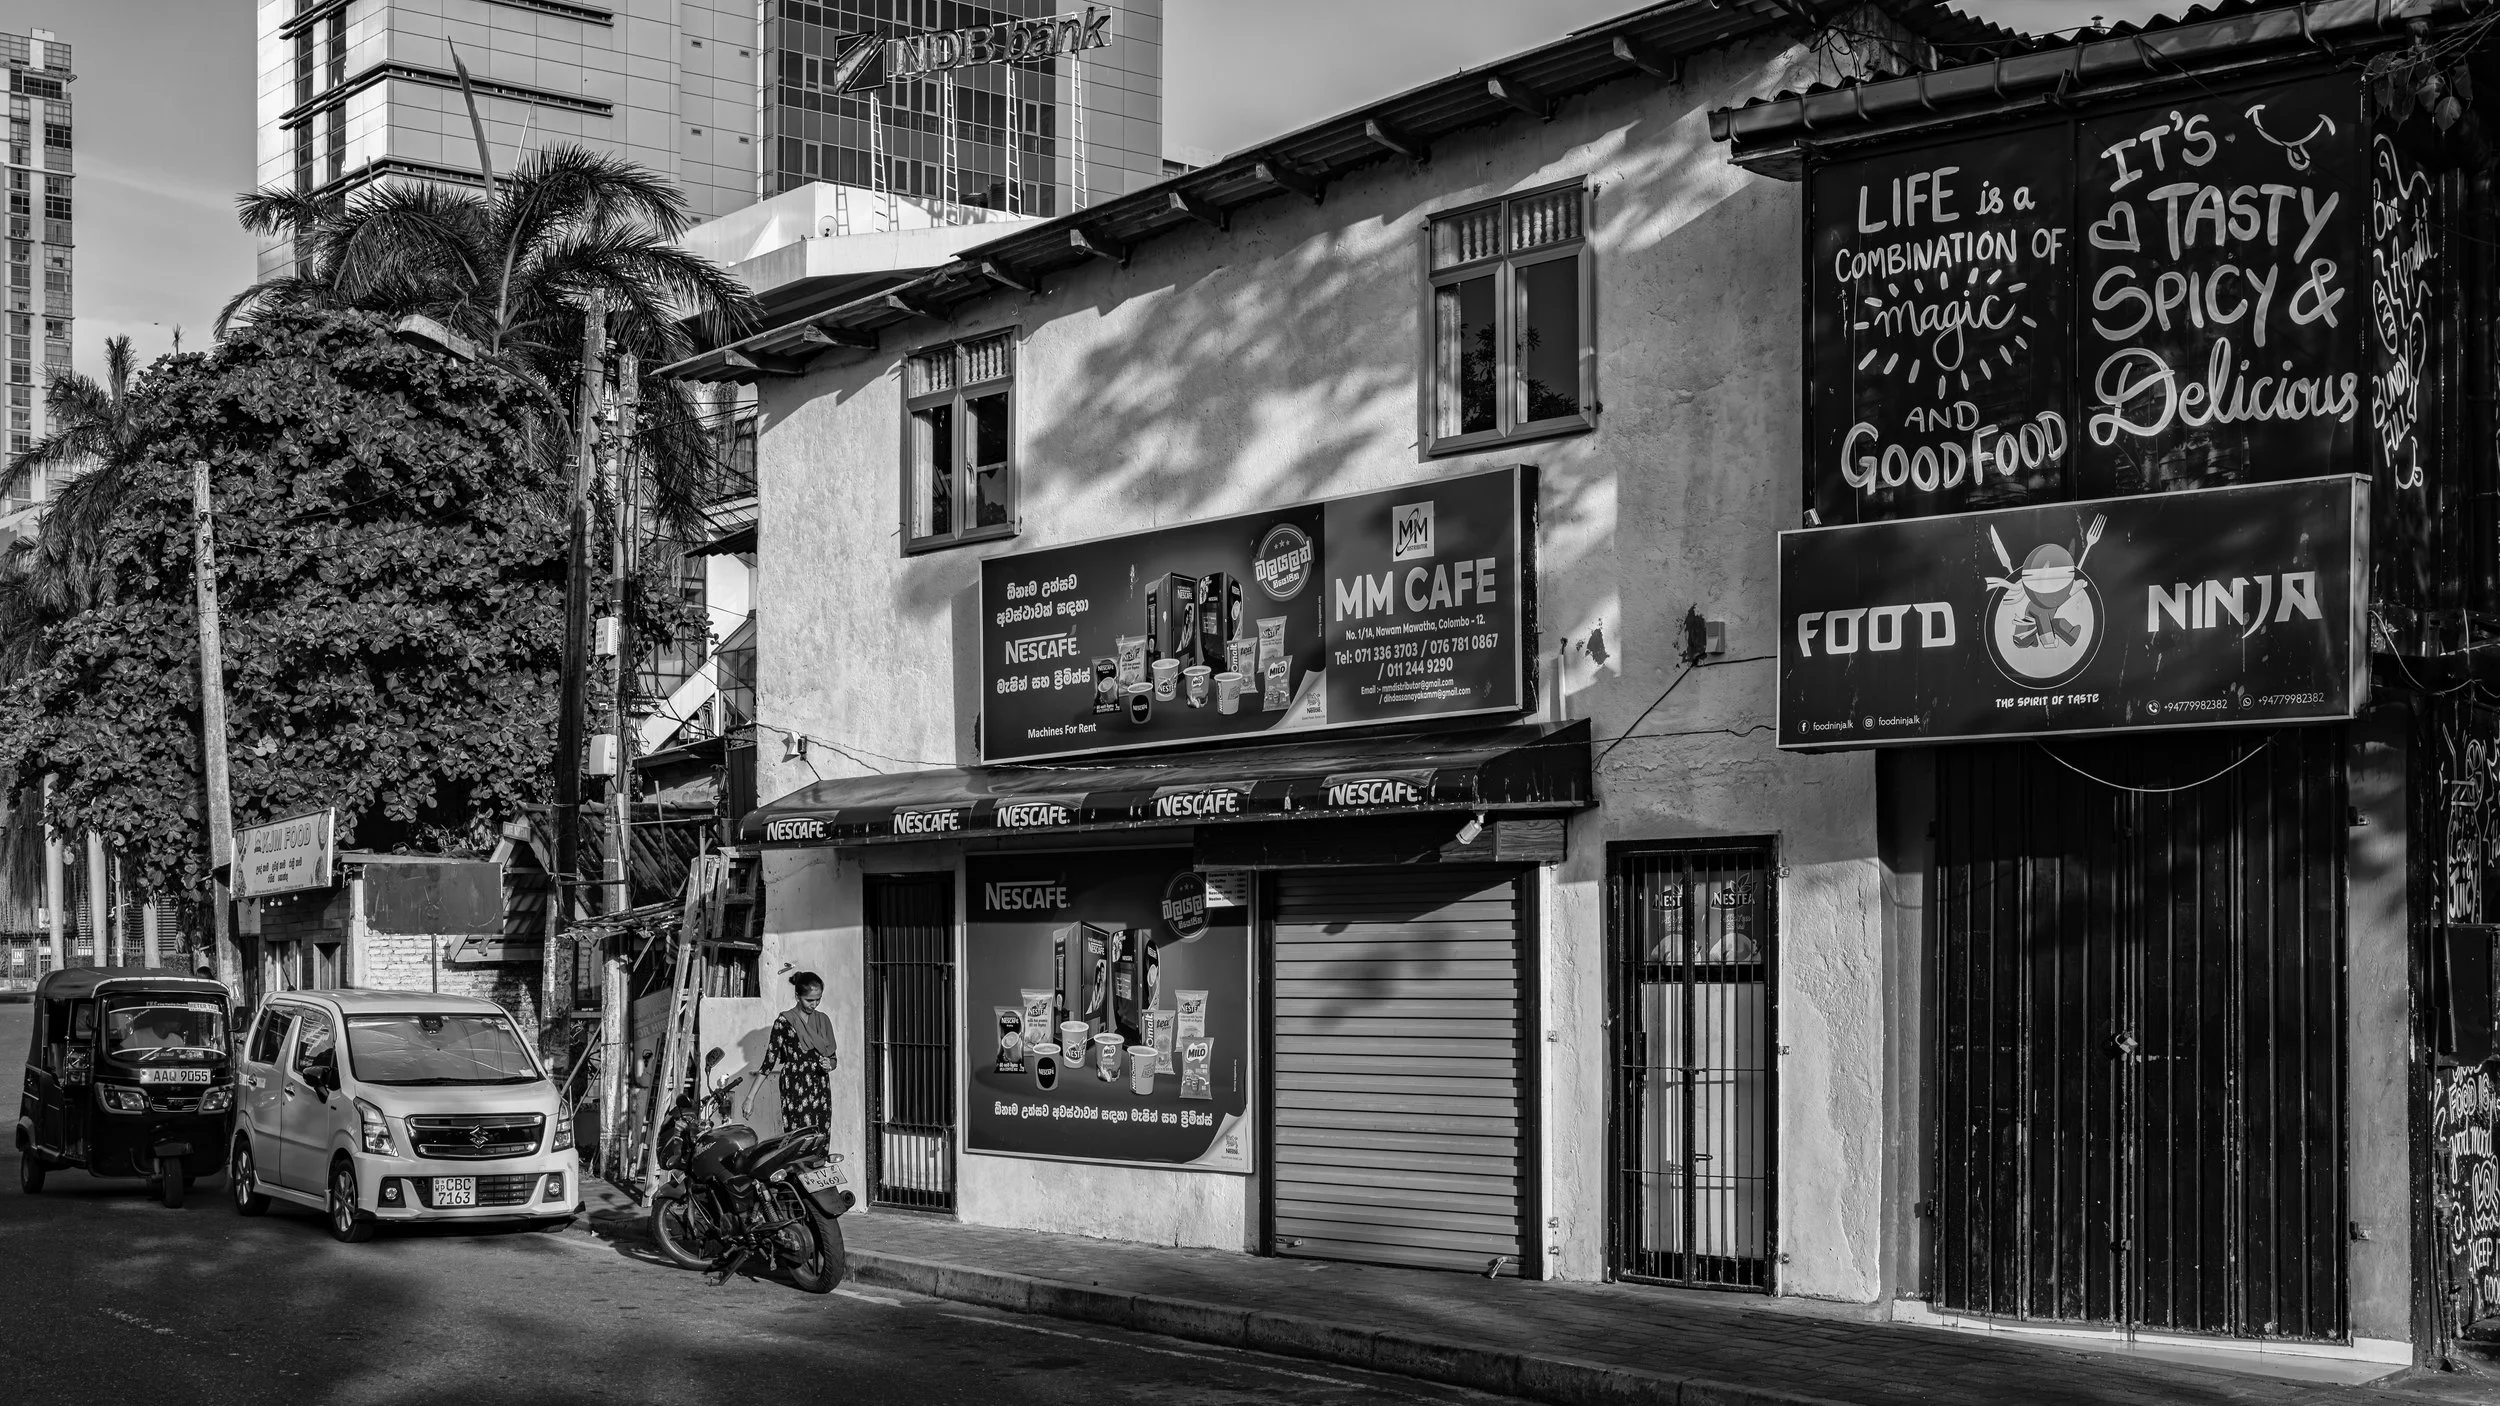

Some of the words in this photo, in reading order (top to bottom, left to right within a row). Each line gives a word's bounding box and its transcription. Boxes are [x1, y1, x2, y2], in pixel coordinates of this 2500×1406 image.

[896, 24, 995, 76] NDB
[1002, 7, 1111, 61] bank
[2101, 109, 2218, 193] IT'S
[1857, 166, 1960, 233] LIFE
[1975, 180, 2003, 216] is
[2012, 186, 2036, 210] a
[2146, 181, 2340, 264] TASTY
[1834, 229, 2018, 283] COMBINATION
[2031, 227, 2067, 265] OF
[2091, 263, 2280, 348] SPICY
[2288, 257, 2347, 329] &
[1873, 290, 2018, 371] magic
[2088, 336, 2360, 446] Delicious
[1904, 400, 1980, 432] AND
[2382, 404, 2411, 468] FULL
[1399, 516, 1428, 546] MM
[1006, 580, 1038, 600] ඕනෑම
[1041, 573, 1078, 598] උත්සව
[1335, 570, 1394, 622] MM
[1404, 557, 1497, 613] CAFE
[1056, 598, 1089, 617] සඳහා
[1798, 601, 1956, 657] FOOD
[2147, 570, 2324, 639] NINJA
[1345, 630, 1357, 641] No.
[1375, 624, 1402, 637] Nawam
[1402, 620, 1438, 634] Mawatha,
[1438, 616, 1470, 630] Colombo
[1335, 651, 1353, 666] Tel:
[1355, 648, 1371, 663] 071
[1373, 645, 1392, 661] 336
[1394, 642, 1418, 659] 3703
[1420, 639, 1428, 658] /
[1430, 638, 1450, 655] 076
[1451, 636, 1469, 652] 781
[1471, 633, 1499, 650] 0867
[1269, 666, 1286, 676] MILO
[1378, 662, 1385, 681] /
[1387, 661, 1403, 678] 011
[1405, 659, 1425, 676] 244
[1427, 656, 1453, 674] 9290
[1031, 676, 1050, 690] සහ
[1361, 684, 1377, 695] Email
[1996, 697, 2015, 708] THE
[2017, 695, 2049, 707] SPIRIT
[2051, 694, 2066, 705] OF
[2067, 693, 2100, 704] TASTE
[2164, 699, 2228, 711] +94779982382
[2258, 692, 2325, 705] +94779982382
[1027, 725, 1064, 739] Machines
[1064, 724, 1077, 736] For
[1078, 722, 1097, 734] Rent
[1813, 721, 1854, 732] foodninja.lk
[1878, 715, 1921, 727] foodninja.lk
[284, 822, 311, 849] FOOD
[1655, 893, 1682, 907] NEST
[1713, 892, 1756, 905] NESTEA
[14, 951, 22, 959] IN
[1187, 1047, 1206, 1058] MILO
[153, 1070, 177, 1082] AAQ
[180, 1070, 208, 1082] 9055
[2448, 1077, 2477, 1124] FOOD
[1161, 1111, 1178, 1124] සහ
[445, 1178, 472, 1191] CBC
[813, 1169, 827, 1180] TV
[816, 1175, 840, 1187] 5469
[438, 1191, 471, 1205] 7163
[2472, 1237, 2493, 1274] KEEP
